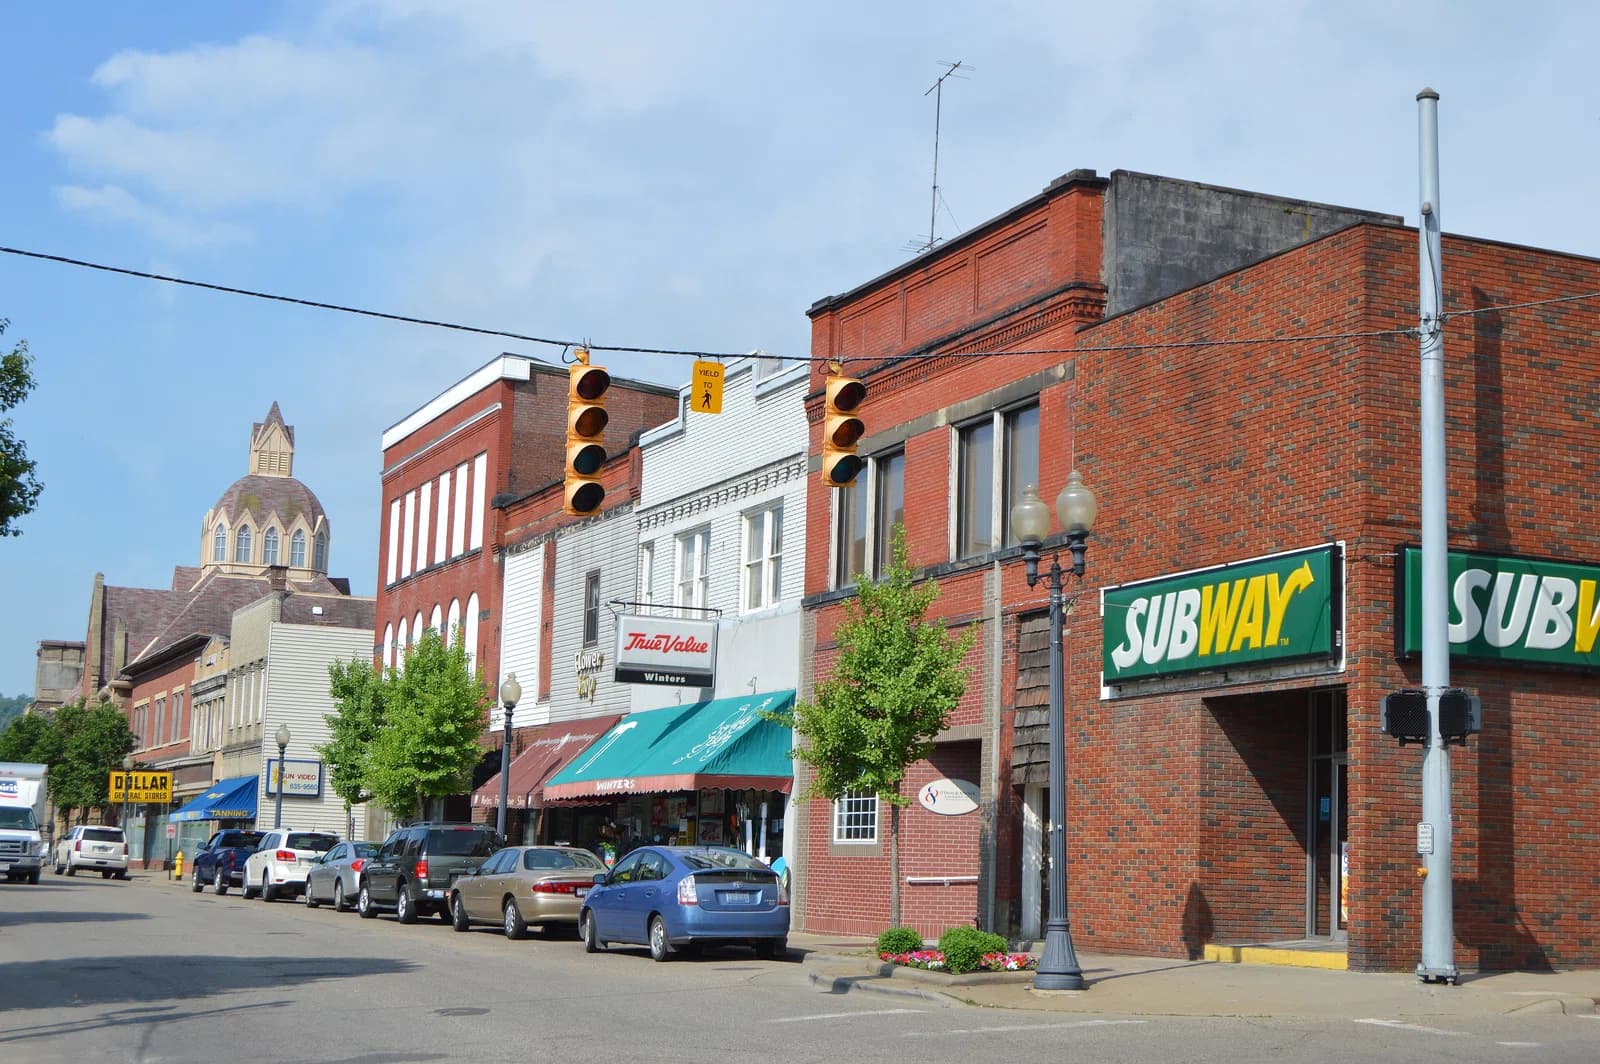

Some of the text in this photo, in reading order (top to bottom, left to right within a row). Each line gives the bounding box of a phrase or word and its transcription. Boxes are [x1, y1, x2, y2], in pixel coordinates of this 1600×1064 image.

[699, 369, 719, 378] YIELD
[703, 381, 713, 389] TO
[1110, 559, 1314, 674] SUBWAY
[644, 672, 686, 683] Winters
[596, 779, 636, 791] WINTERS
[144, 792, 168, 800] STORES
